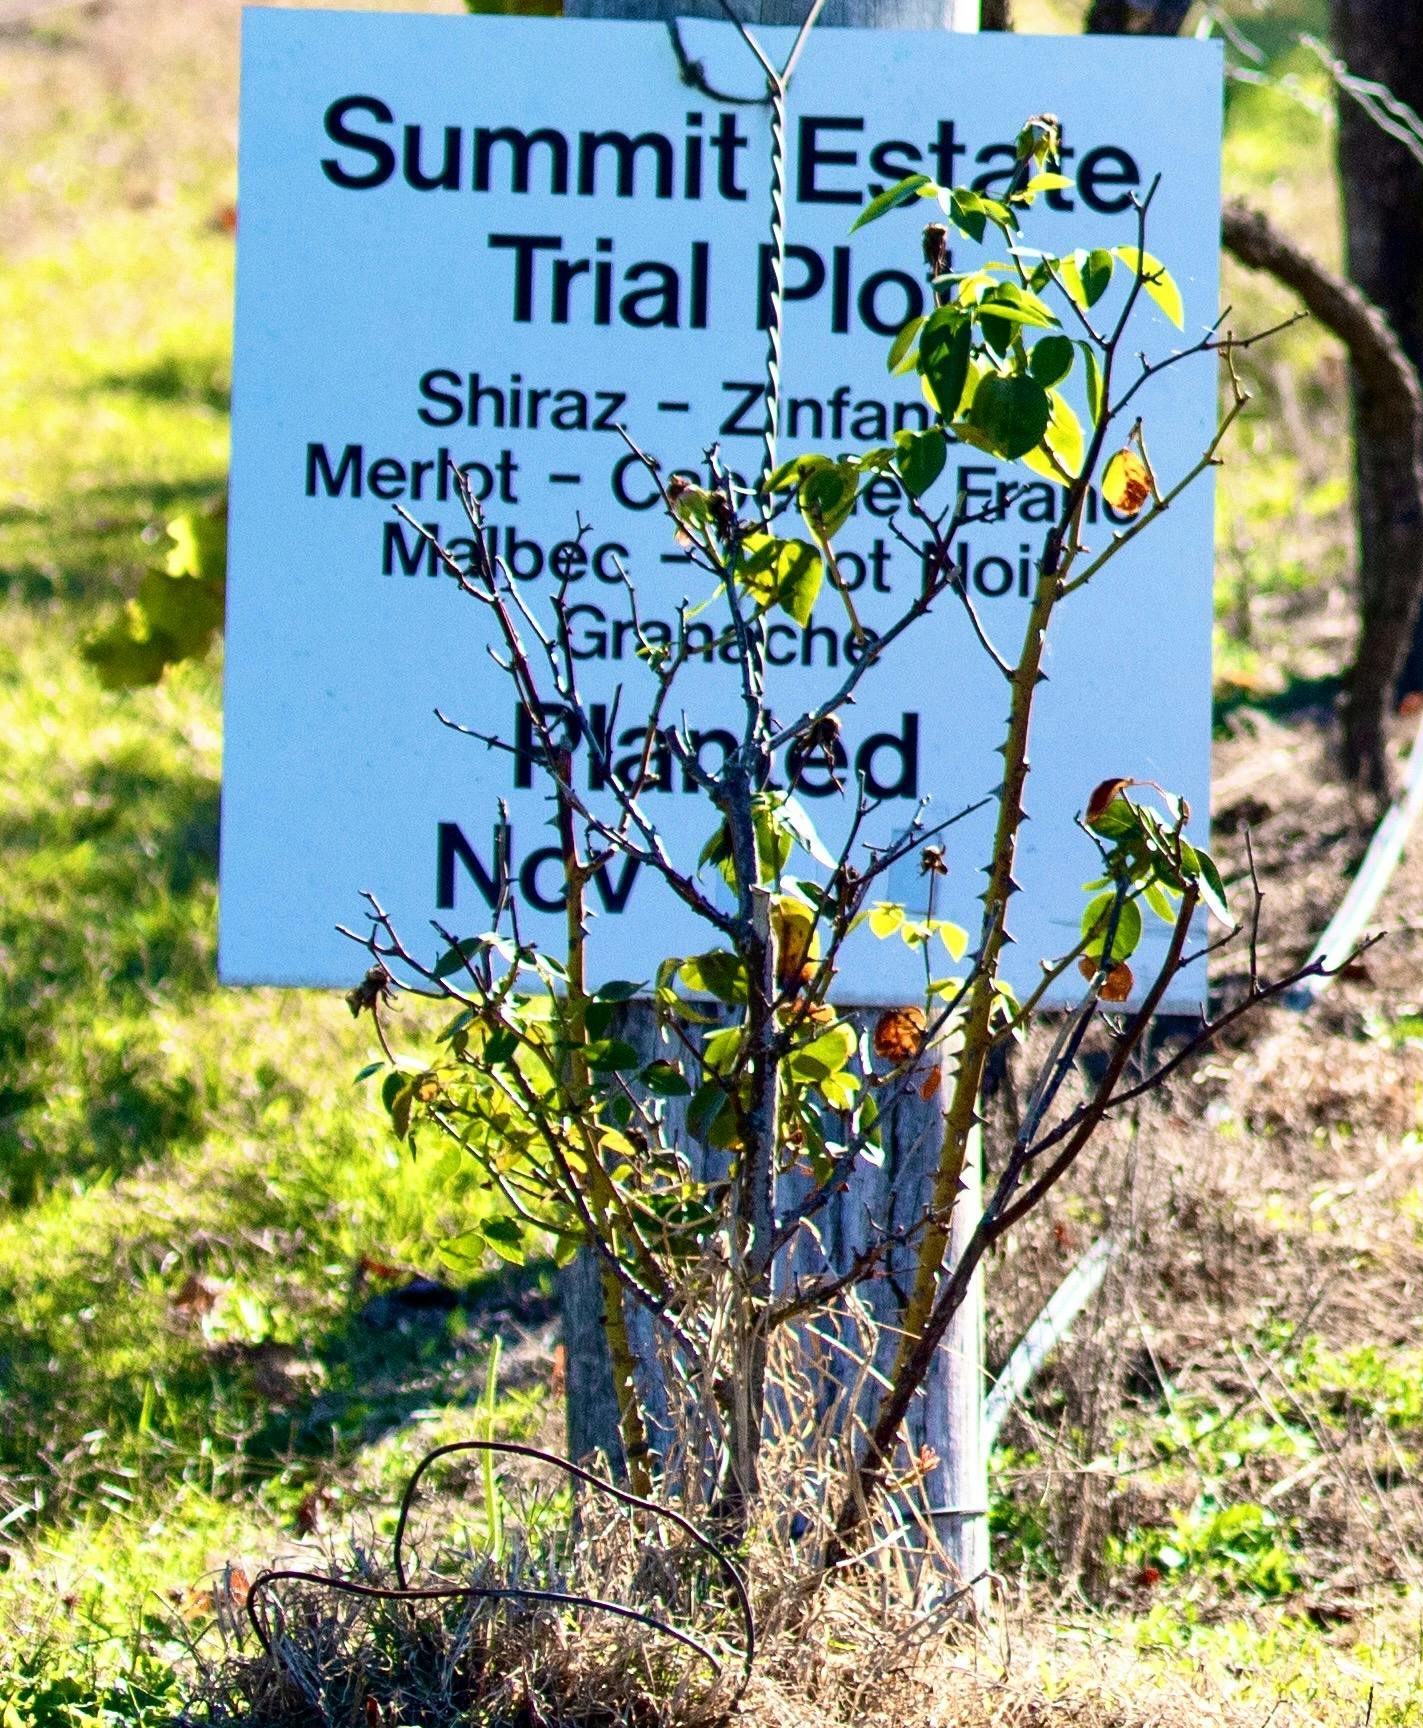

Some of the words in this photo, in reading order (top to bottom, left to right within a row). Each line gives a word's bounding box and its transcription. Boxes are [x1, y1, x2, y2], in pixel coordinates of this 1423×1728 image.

[320, 93, 748, 202] Summit
[487, 232, 709, 330] Trial
[417, 368, 628, 432] Shiraz
[305, 441, 518, 504] Merlot
[381, 520, 631, 583] Malbec
[921, 540, 1047, 598] Noi
[436, 822, 643, 915] Nov
